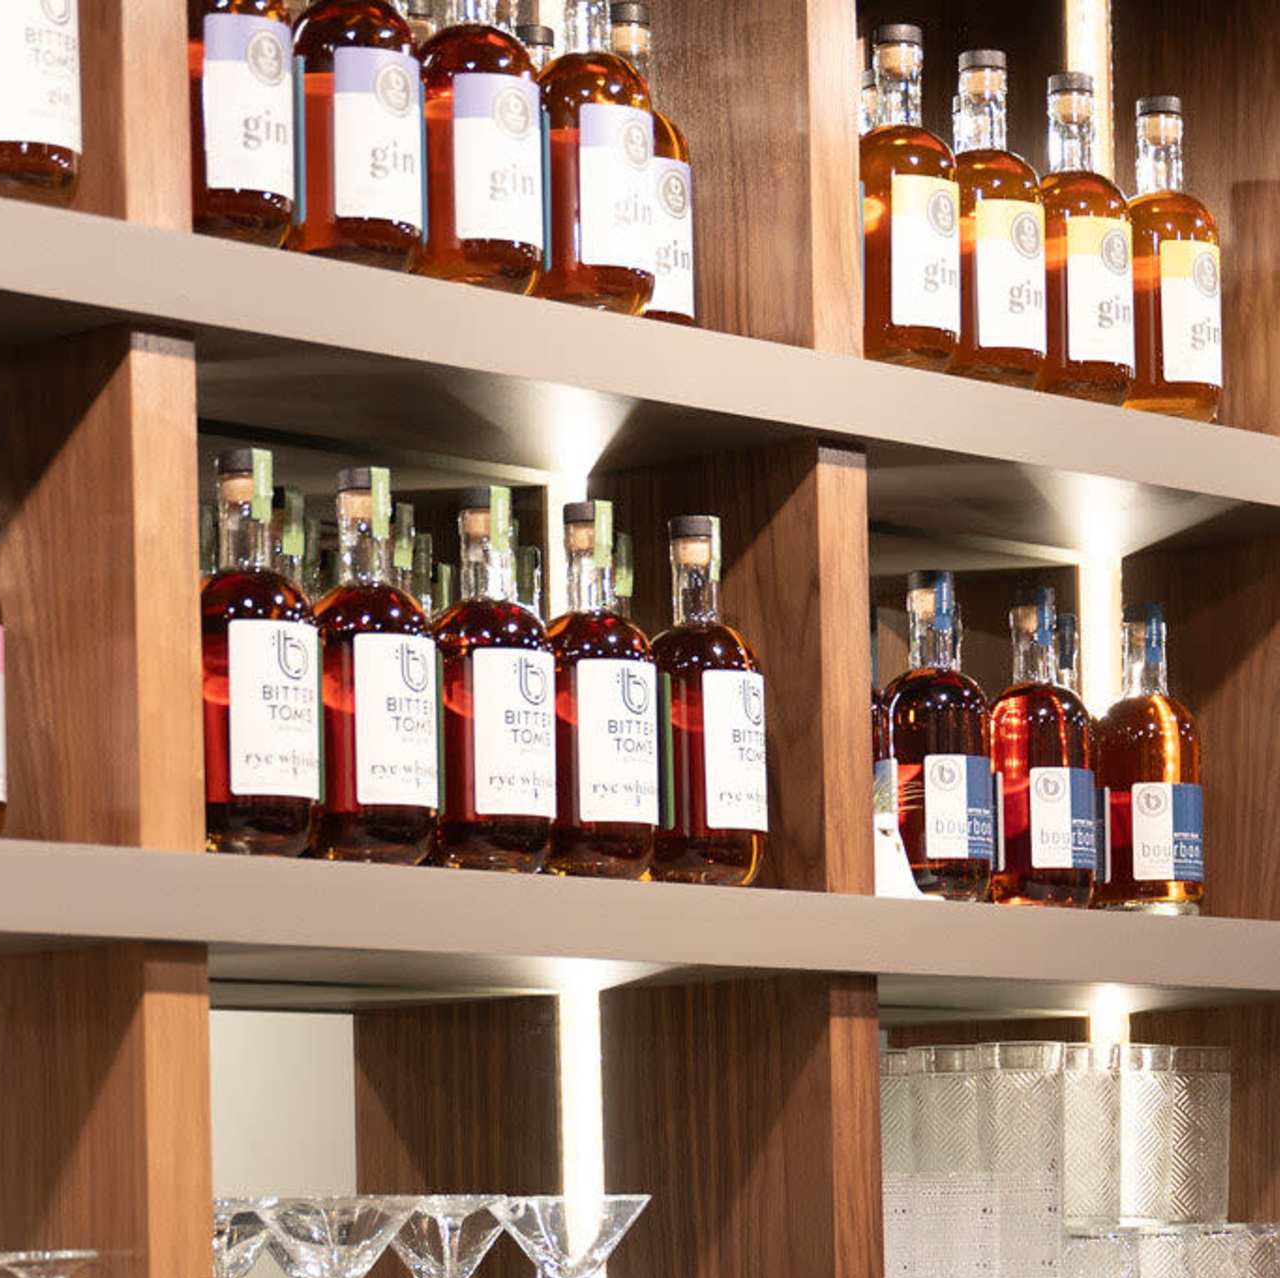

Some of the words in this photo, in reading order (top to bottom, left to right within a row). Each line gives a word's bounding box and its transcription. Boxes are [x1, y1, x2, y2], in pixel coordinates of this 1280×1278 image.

[242, 109, 288, 150] gin
[370, 140, 415, 179] gin
[489, 163, 534, 201] gin
[613, 193, 652, 229] gin
[655, 240, 690, 276] gin
[923, 258, 958, 293] gin
[1008, 280, 1043, 314] gin
[1097, 296, 1131, 329] gin
